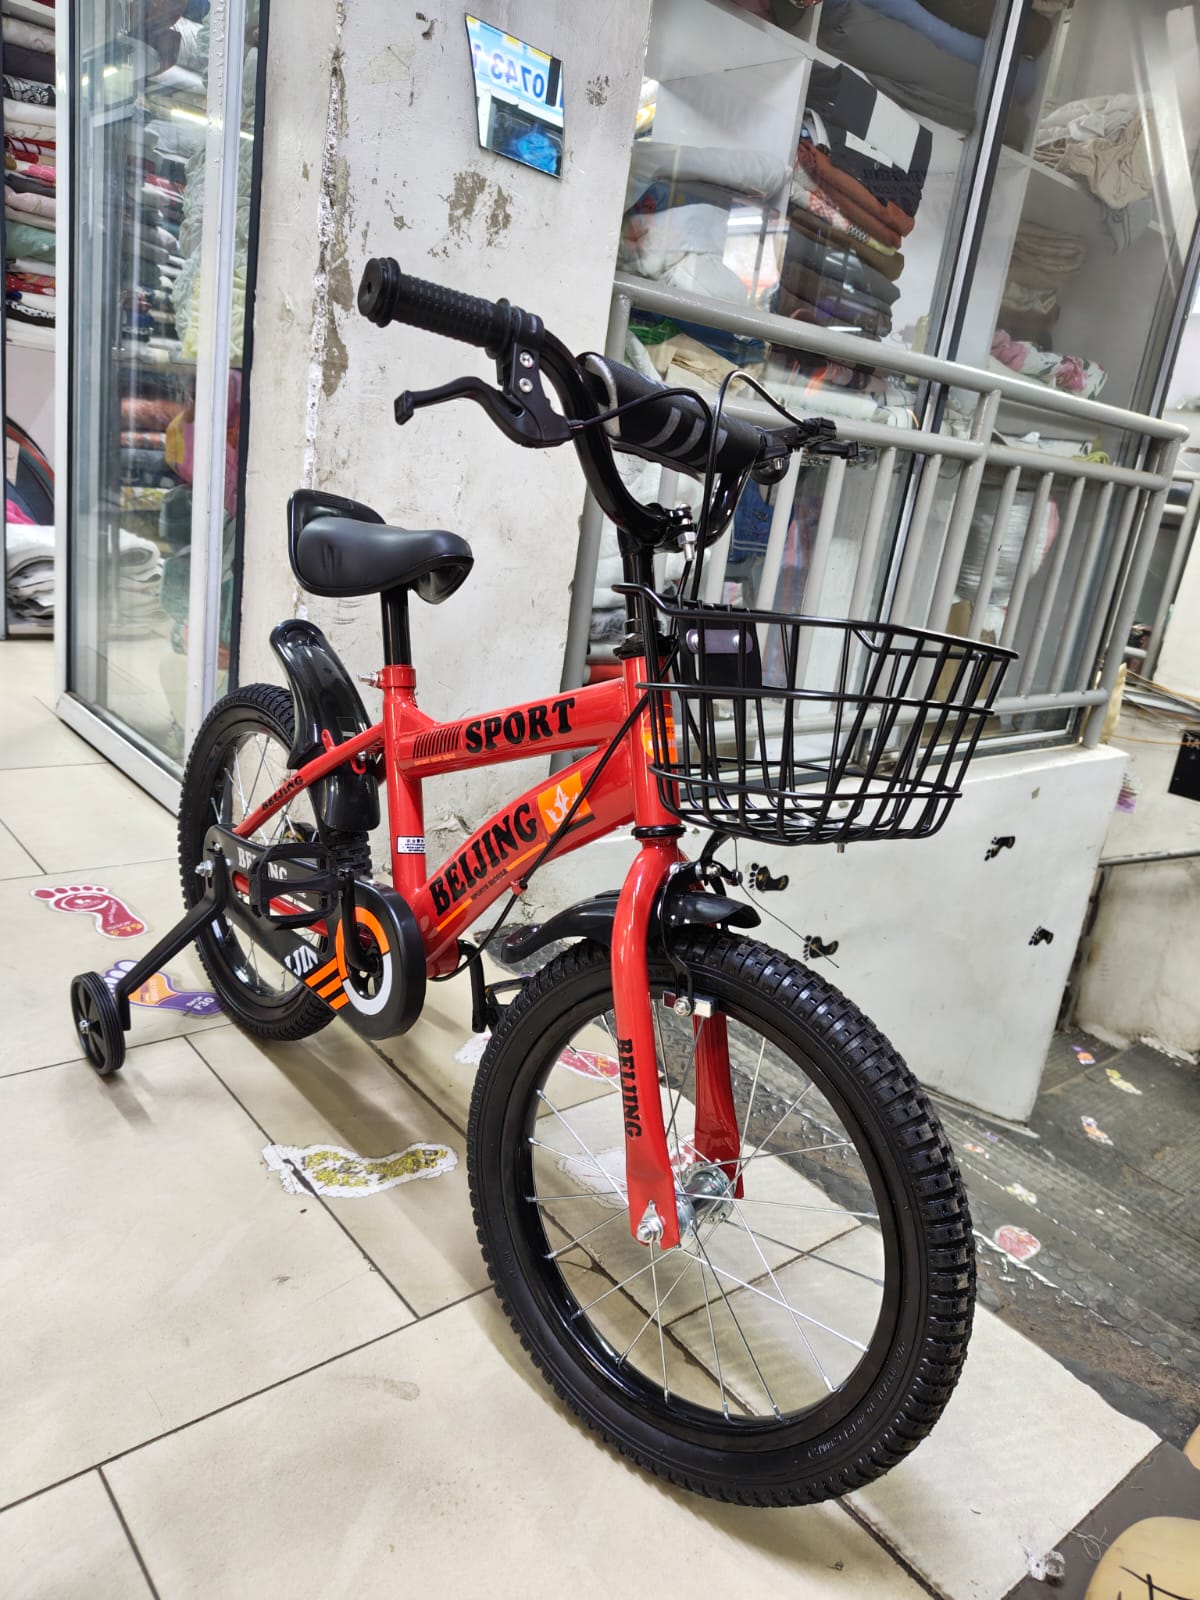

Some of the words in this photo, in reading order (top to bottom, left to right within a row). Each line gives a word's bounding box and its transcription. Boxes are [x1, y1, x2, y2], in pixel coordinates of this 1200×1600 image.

[465, 698, 575, 753] SPORT
[429, 803, 537, 916] BEIJING
[618, 1039, 642, 1138] BEIJING
